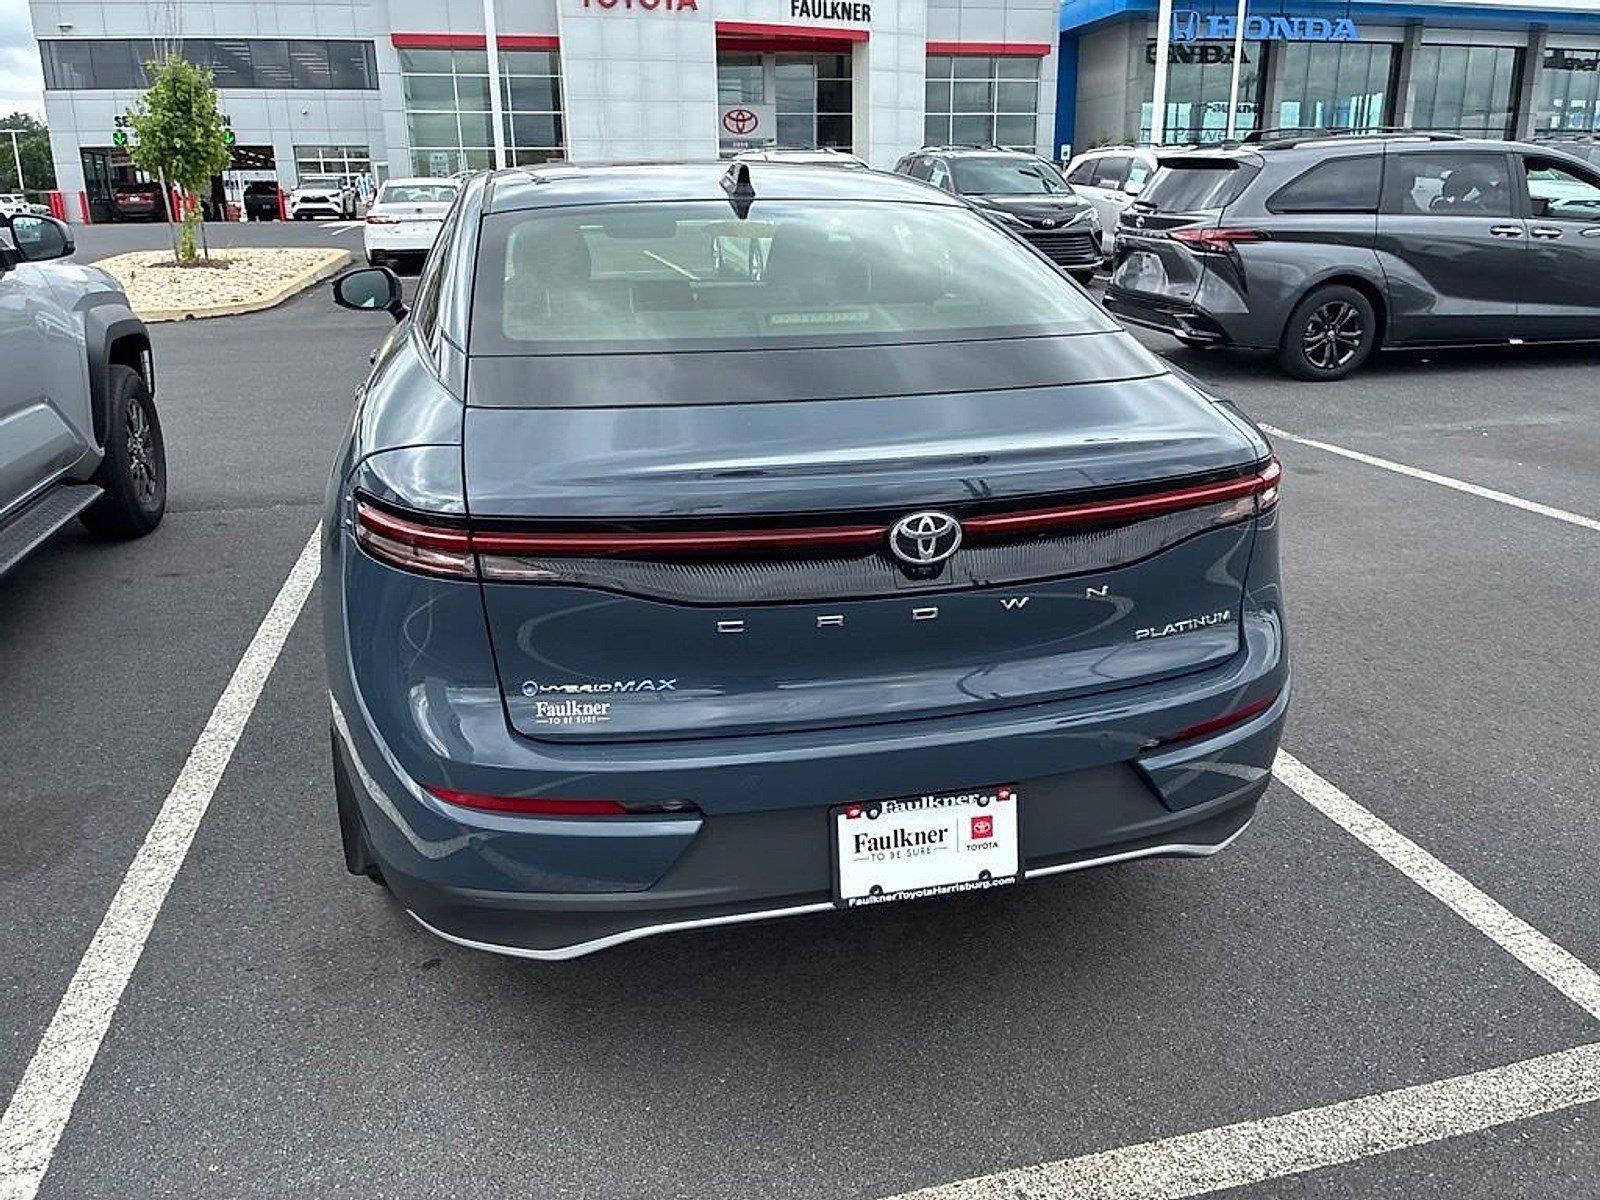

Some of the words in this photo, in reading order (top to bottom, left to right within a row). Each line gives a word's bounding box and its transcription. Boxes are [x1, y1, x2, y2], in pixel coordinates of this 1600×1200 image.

[791, 0, 871, 22] FAULKNER
[1206, 15, 1359, 40] HONDA
[1135, 610, 1230, 639] PLATINUM
[536, 700, 611, 717] Faulkner
[548, 717, 560, 725] TO
[880, 793, 980, 814] Faulkner
[853, 828, 948, 853] Faulkner
[966, 841, 999, 852] TOYOTA
[871, 852, 886, 861] TO
[890, 850, 902, 859] BE
[906, 846, 932, 858] SURE
[849, 876, 1016, 907] FaulknerToyotaHarrisburg.com
